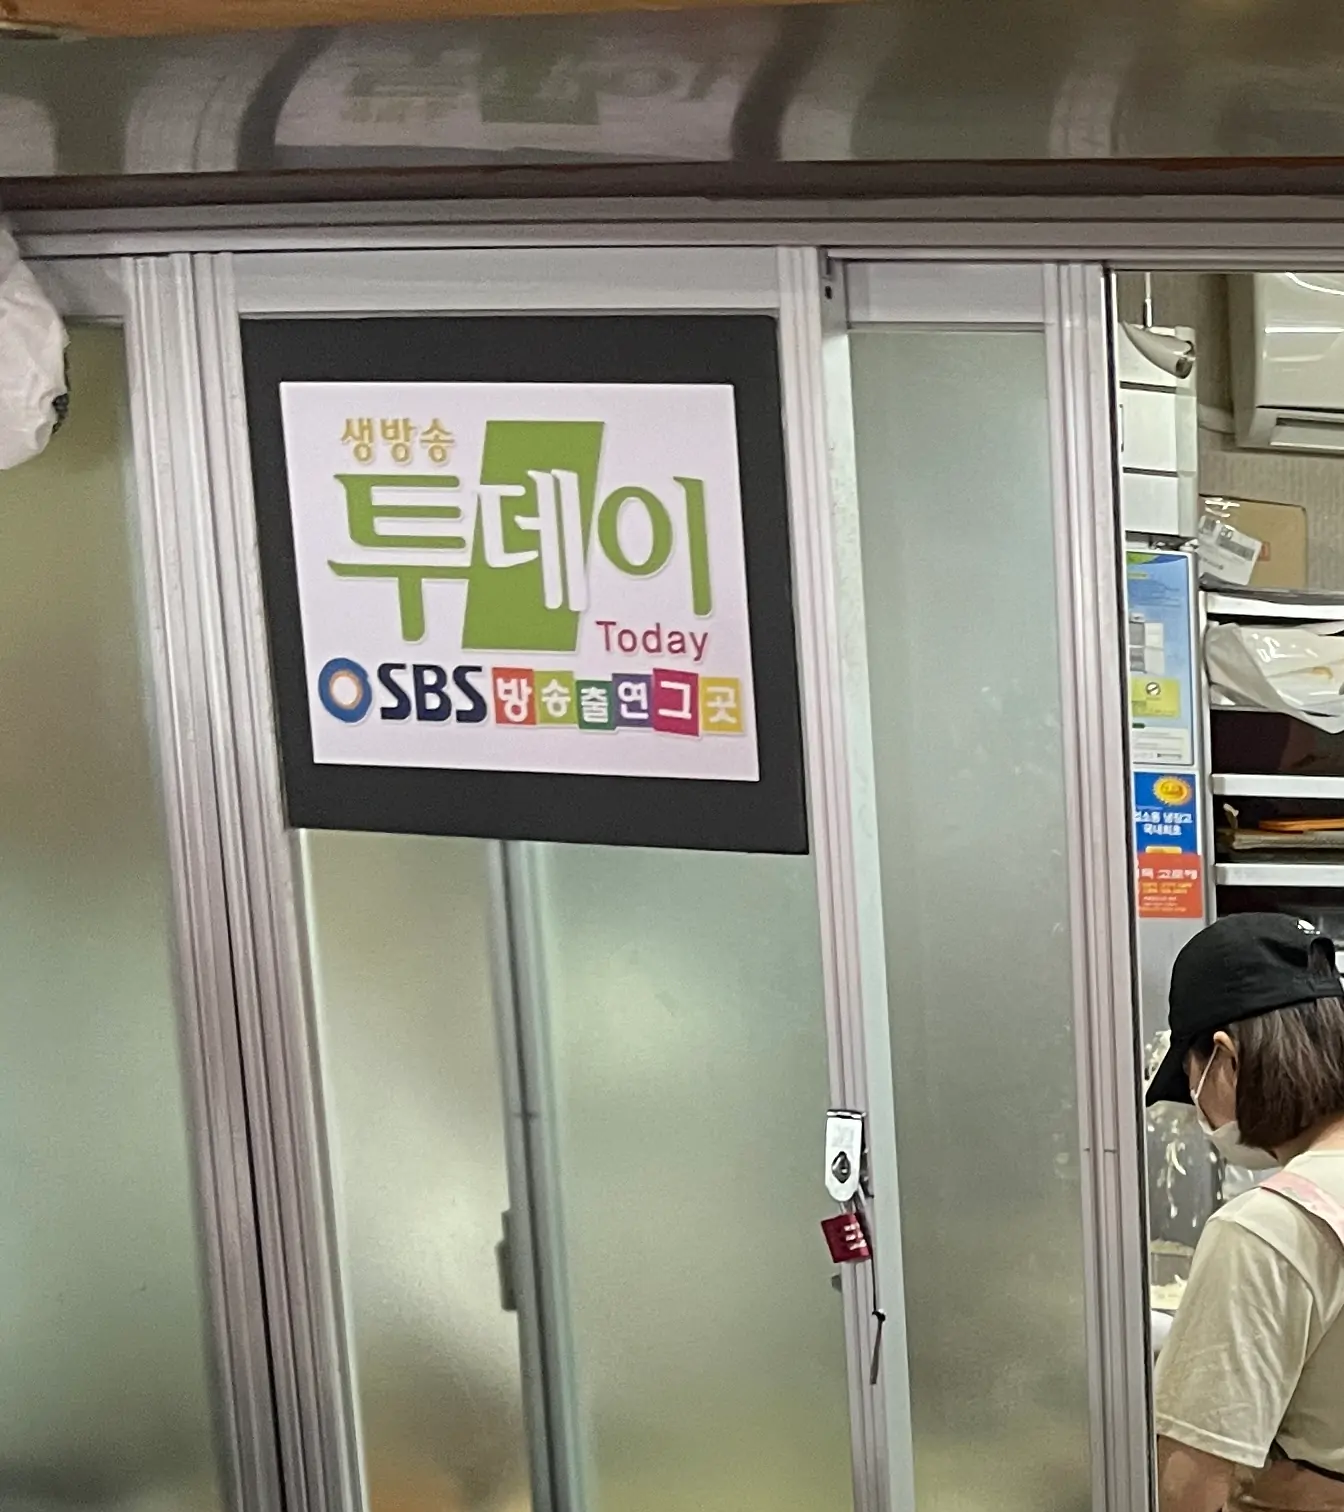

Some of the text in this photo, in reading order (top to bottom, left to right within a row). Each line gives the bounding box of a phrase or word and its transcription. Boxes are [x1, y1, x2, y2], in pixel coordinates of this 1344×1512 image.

[340, 417, 455, 464] 생방송
[326, 467, 713, 643] 투데이
[596, 620, 708, 661] Today
[378, 663, 488, 724] SBS
